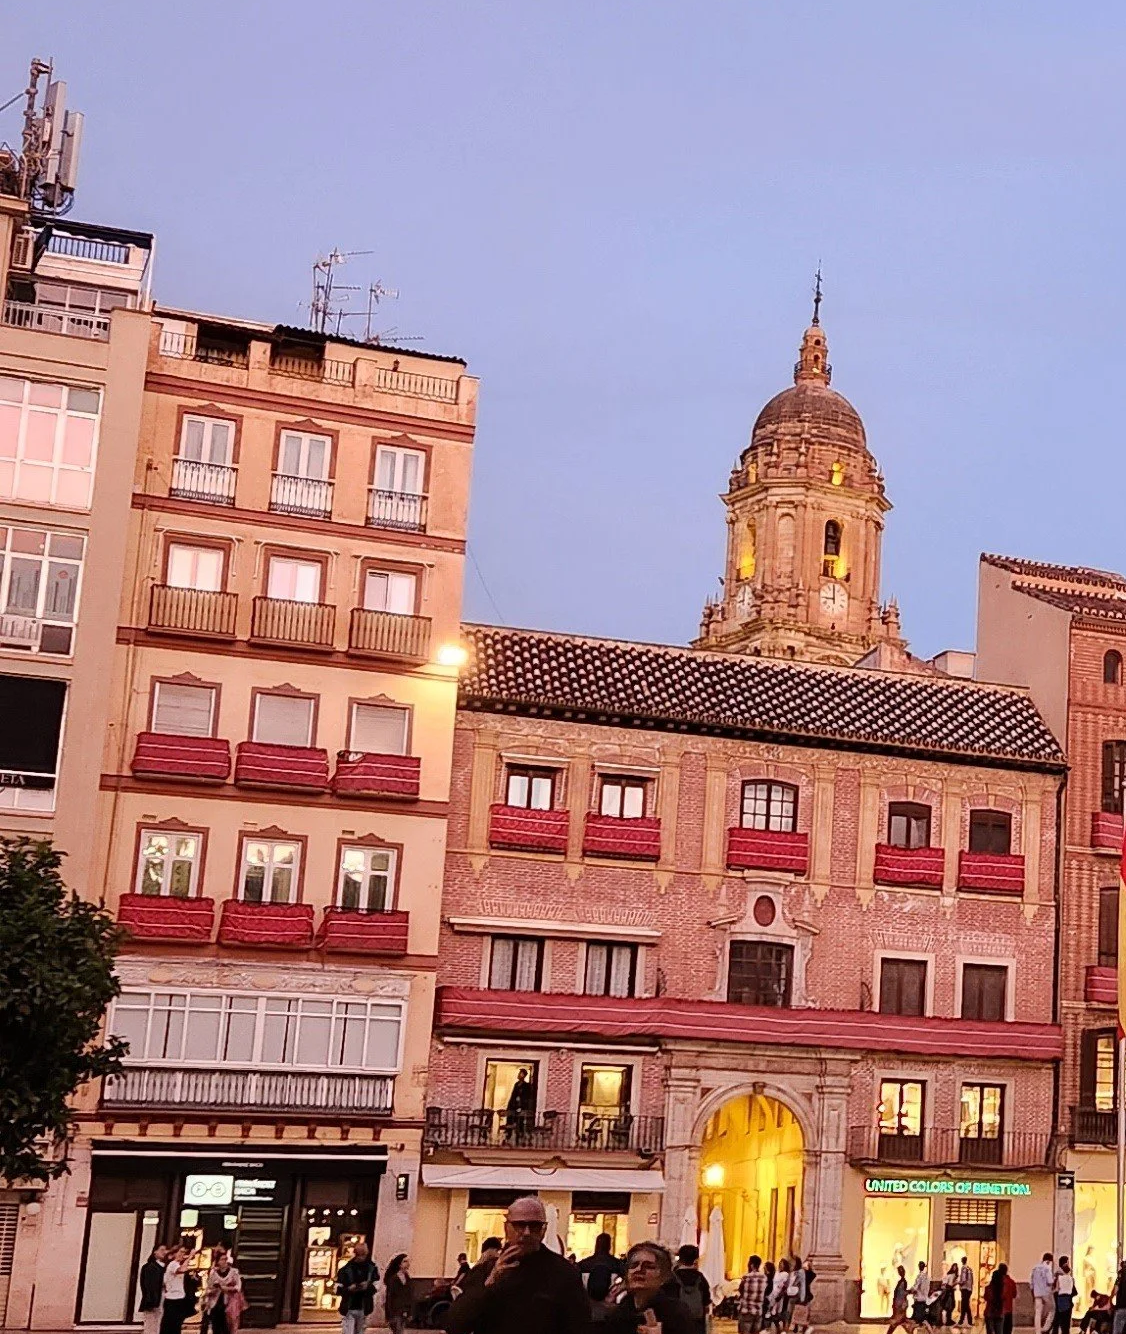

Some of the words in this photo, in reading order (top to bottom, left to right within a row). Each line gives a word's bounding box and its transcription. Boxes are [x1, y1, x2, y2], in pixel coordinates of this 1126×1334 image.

[865, 1179, 908, 1193] UNITED
[909, 1180, 954, 1193] COLORS
[955, 1181, 971, 1194] OF
[972, 1181, 1032, 1196] BENETTON
